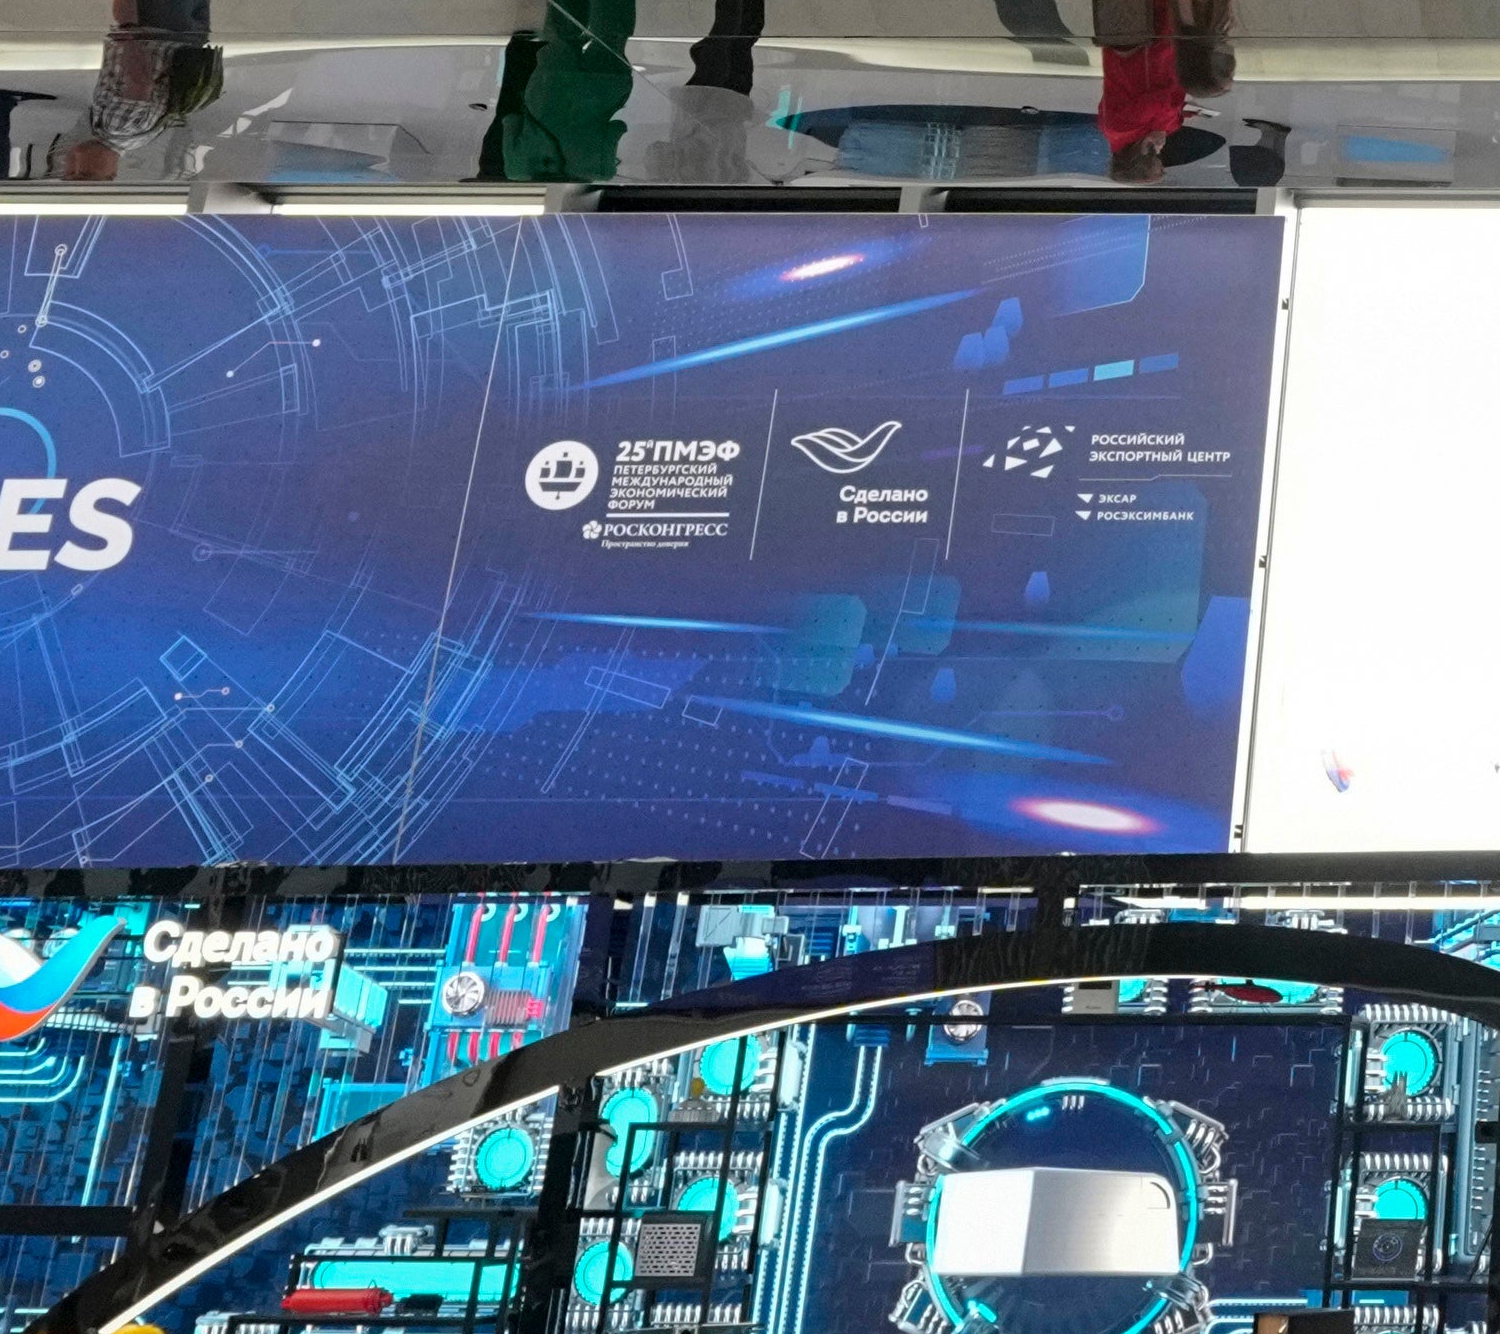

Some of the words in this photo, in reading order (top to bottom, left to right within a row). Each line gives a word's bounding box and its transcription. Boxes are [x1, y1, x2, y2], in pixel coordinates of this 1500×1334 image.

[1091, 433, 1185, 445] РОССИЙСКИЙ
[1089, 449, 1183, 462] ЭКСПОРТНЫЙ
[1187, 450, 1231, 463] ЦЕНТР
[613, 463, 717, 475] ПЕТЕРБУРГСКИЙ
[611, 474, 733, 486] МЕЖДУНАРОДНЫЙ
[610, 486, 727, 498] ЭКОНОМИЧЕСКИЙ
[839, 485, 928, 505] Сделано
[1098, 493, 1136, 503] ЭКСАР
[608, 499, 655, 511] ФОРУМ
[836, 509, 850, 522] в
[853, 507, 928, 523] России
[1097, 510, 1194, 521] РОСЭКСИМБАНК
[603, 523, 728, 537] РОСКОНГРЕСС
[142, 919, 337, 966] Сделано
[129, 984, 155, 1019] в
[164, 975, 333, 1020] России
